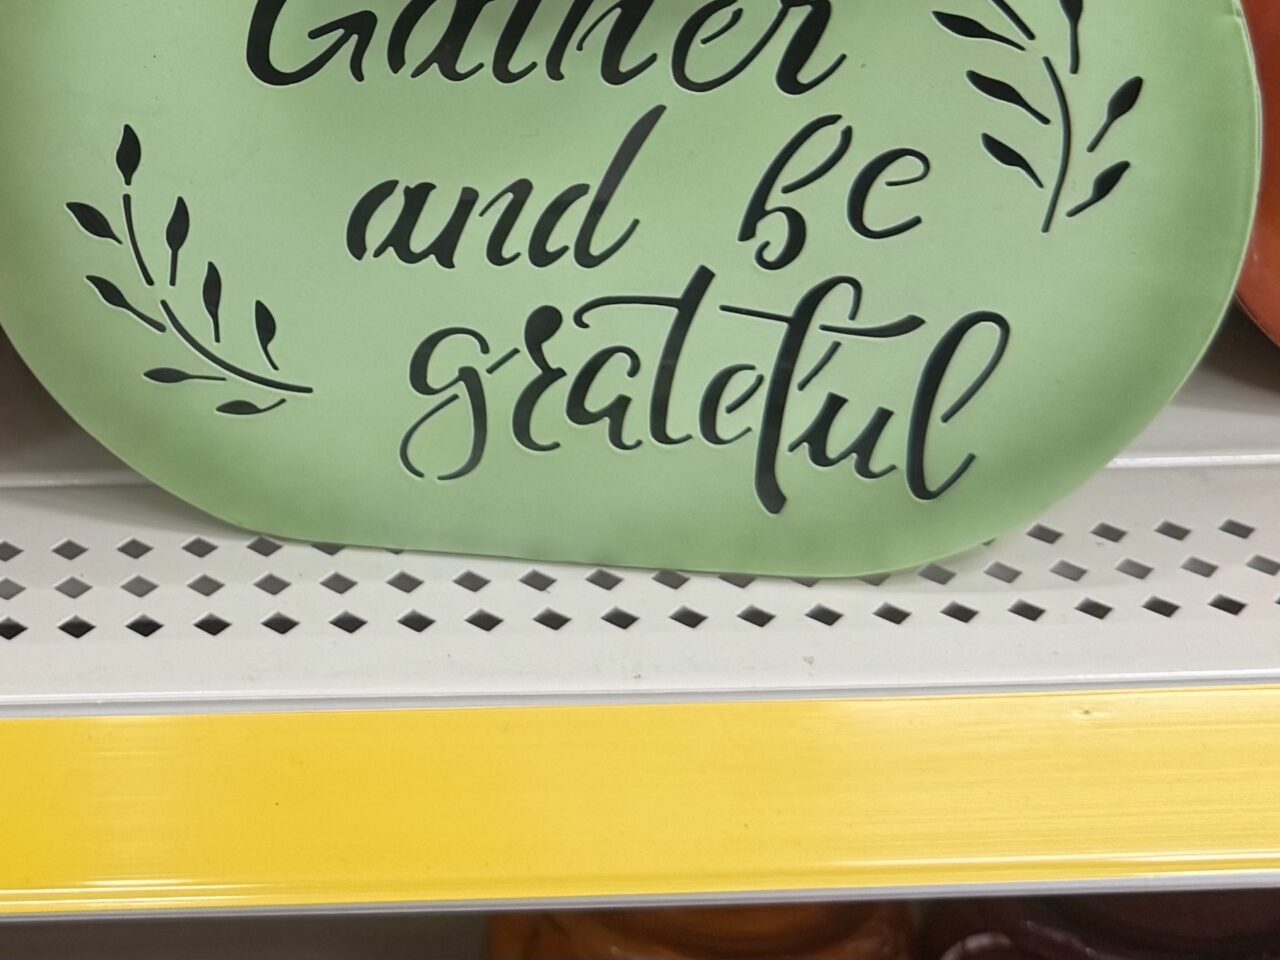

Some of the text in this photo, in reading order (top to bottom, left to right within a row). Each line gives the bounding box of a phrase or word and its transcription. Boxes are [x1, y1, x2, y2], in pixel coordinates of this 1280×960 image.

[345, 104, 931, 271] and be
[398, 264, 1012, 515] grateful
